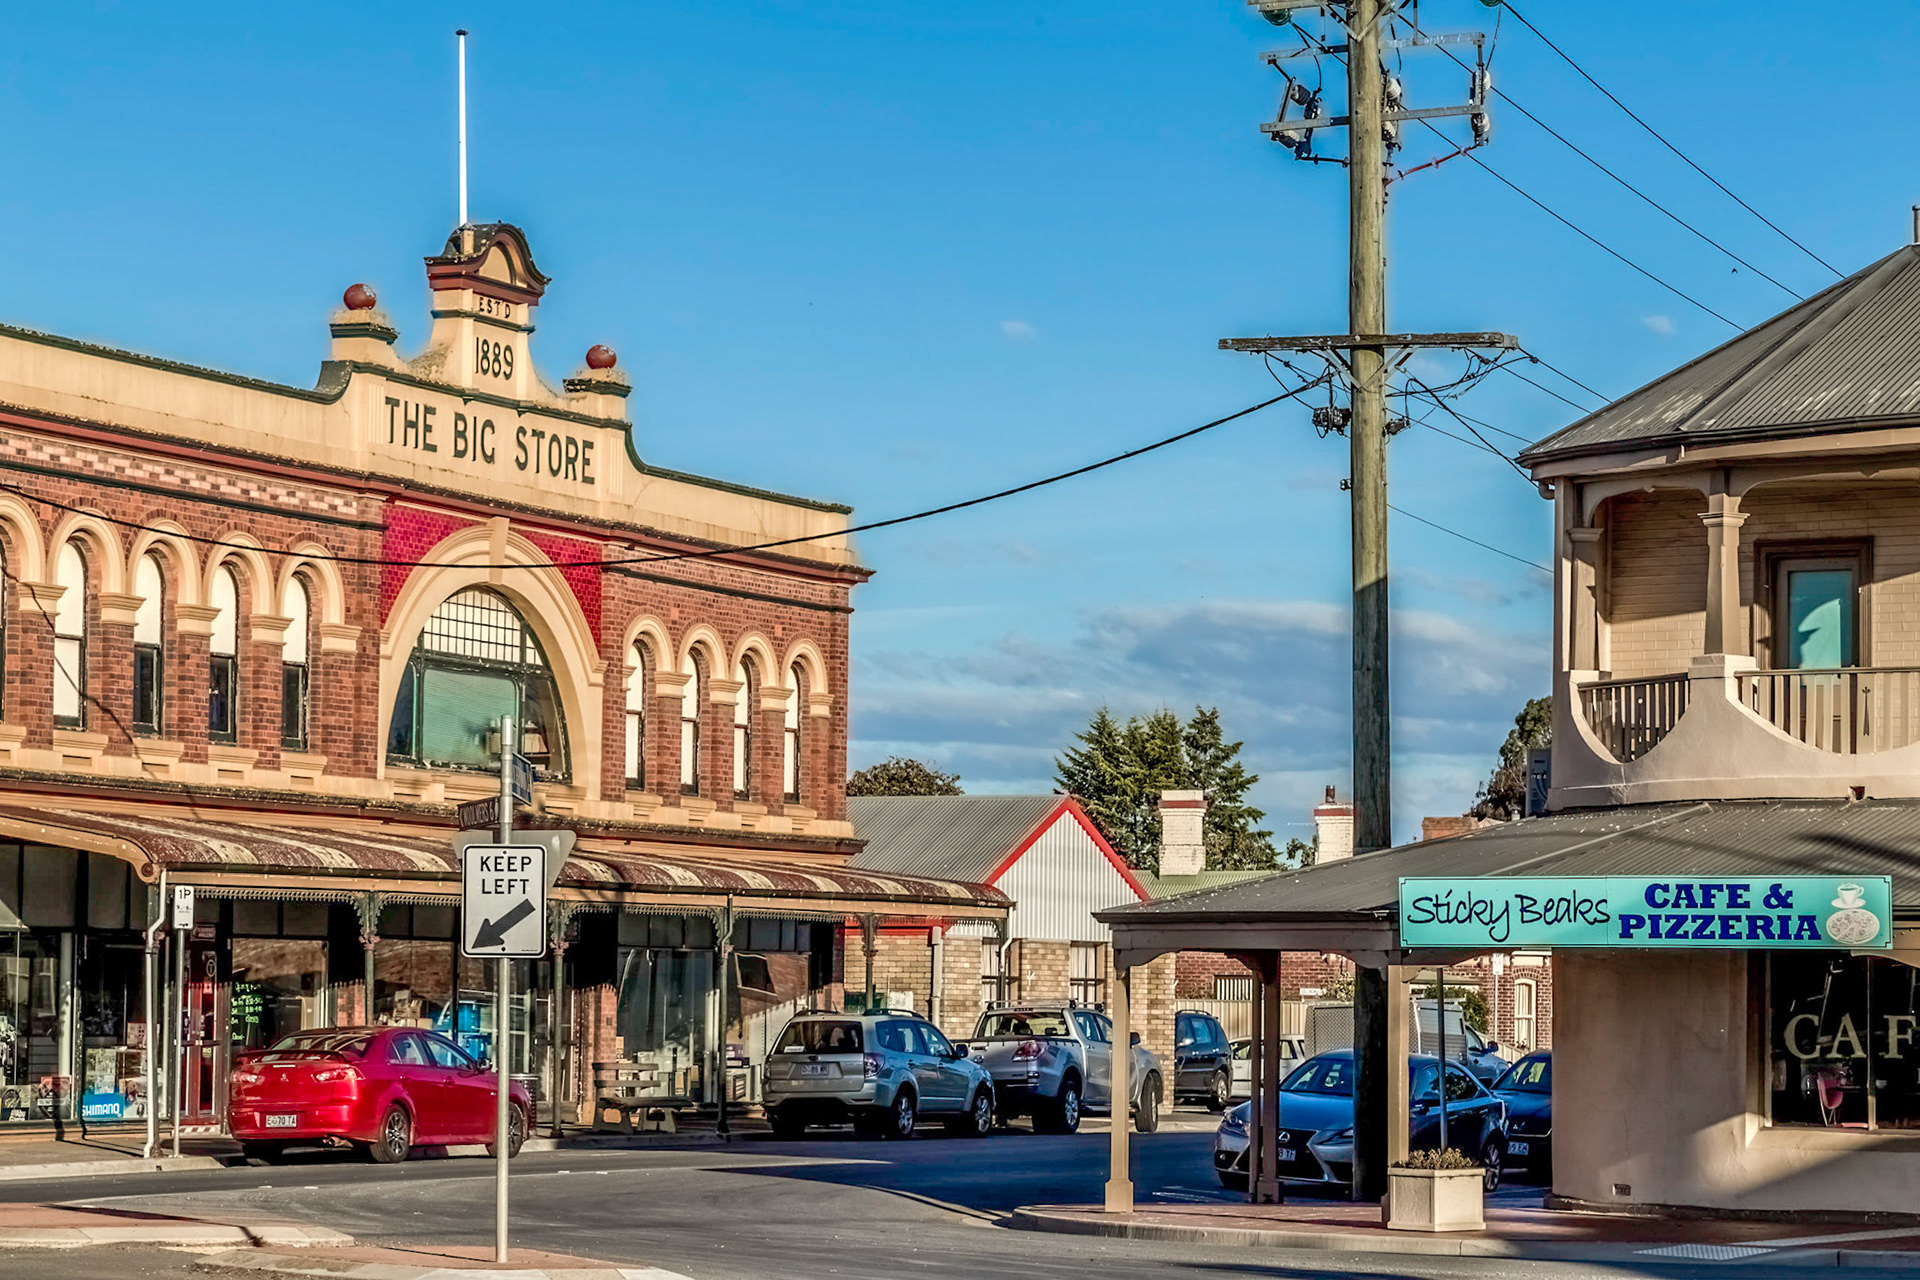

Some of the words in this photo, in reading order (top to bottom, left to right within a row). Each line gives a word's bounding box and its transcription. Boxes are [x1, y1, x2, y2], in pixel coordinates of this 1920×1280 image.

[475, 336, 514, 380] 1889
[385, 396, 438, 452] THE
[453, 411, 495, 464] BIG
[515, 426, 594, 484] STORE
[480, 856, 532, 872] KEEP
[179, 889, 191, 899] 1P
[481, 879, 529, 894] LEFT
[1644, 883, 1751, 909] CAFE
[1762, 883, 1793, 909] &
[1407, 889, 1510, 942] Sticky
[1514, 889, 1611, 925] Beaks
[1618, 914, 1822, 940] PIZZERIA
[82, 1103, 119, 1116] SHIMANO
[278, 1116, 286, 1125] 70
